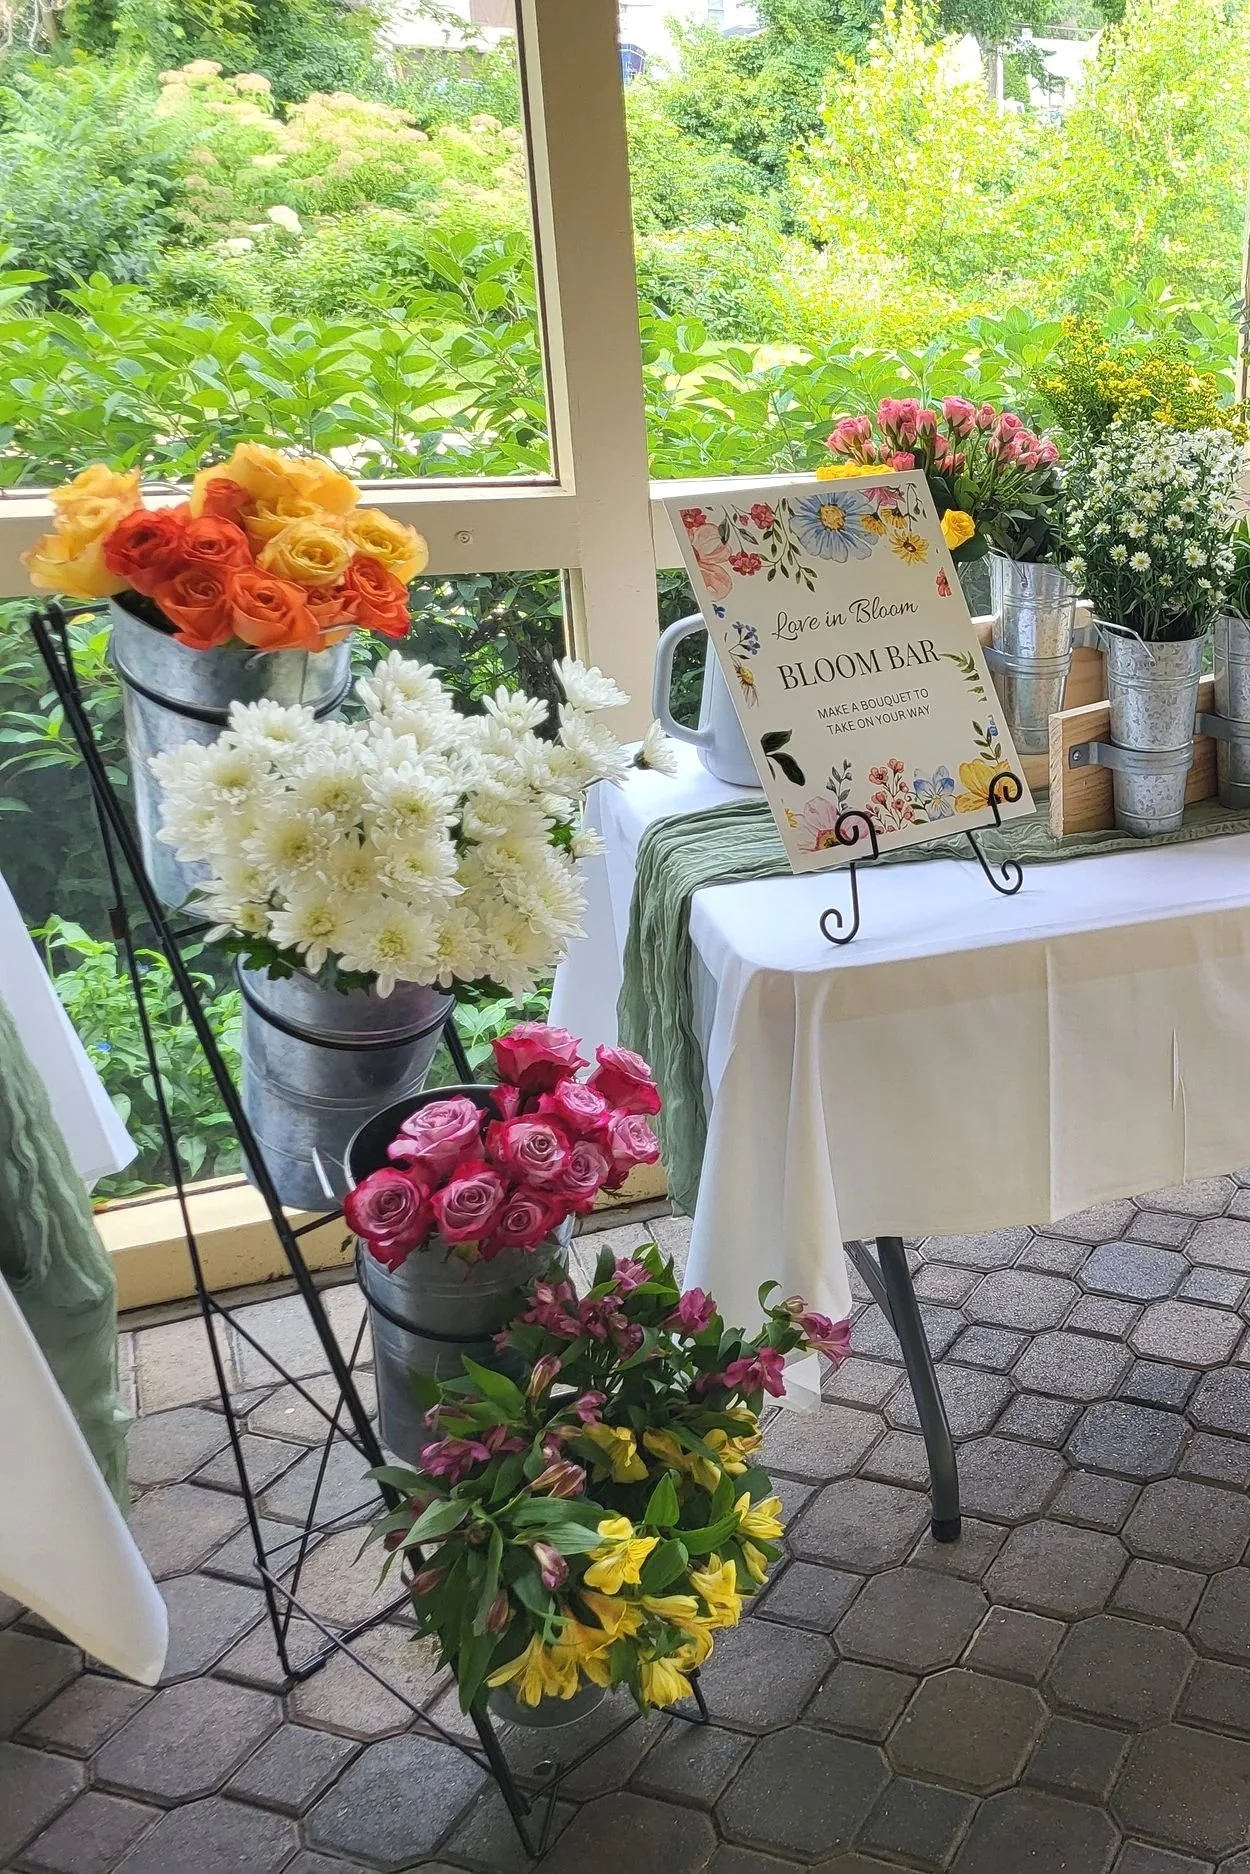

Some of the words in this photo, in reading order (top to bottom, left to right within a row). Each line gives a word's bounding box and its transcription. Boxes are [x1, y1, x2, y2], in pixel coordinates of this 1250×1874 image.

[771, 611, 820, 641] Love
[825, 610, 847, 628] in
[848, 596, 919, 624] Bloom
[776, 648, 883, 691] BLOOM
[885, 639, 942, 670] BAR
[817, 704, 850, 720] MAKE
[851, 702, 860, 713] A
[860, 691, 912, 711] BOUQUET
[913, 688, 929, 700] TO
[826, 720, 856, 735] TAKE
[857, 717, 875, 729] ON
[875, 710, 907, 725] YOUR
[906, 704, 931, 719] WAY
